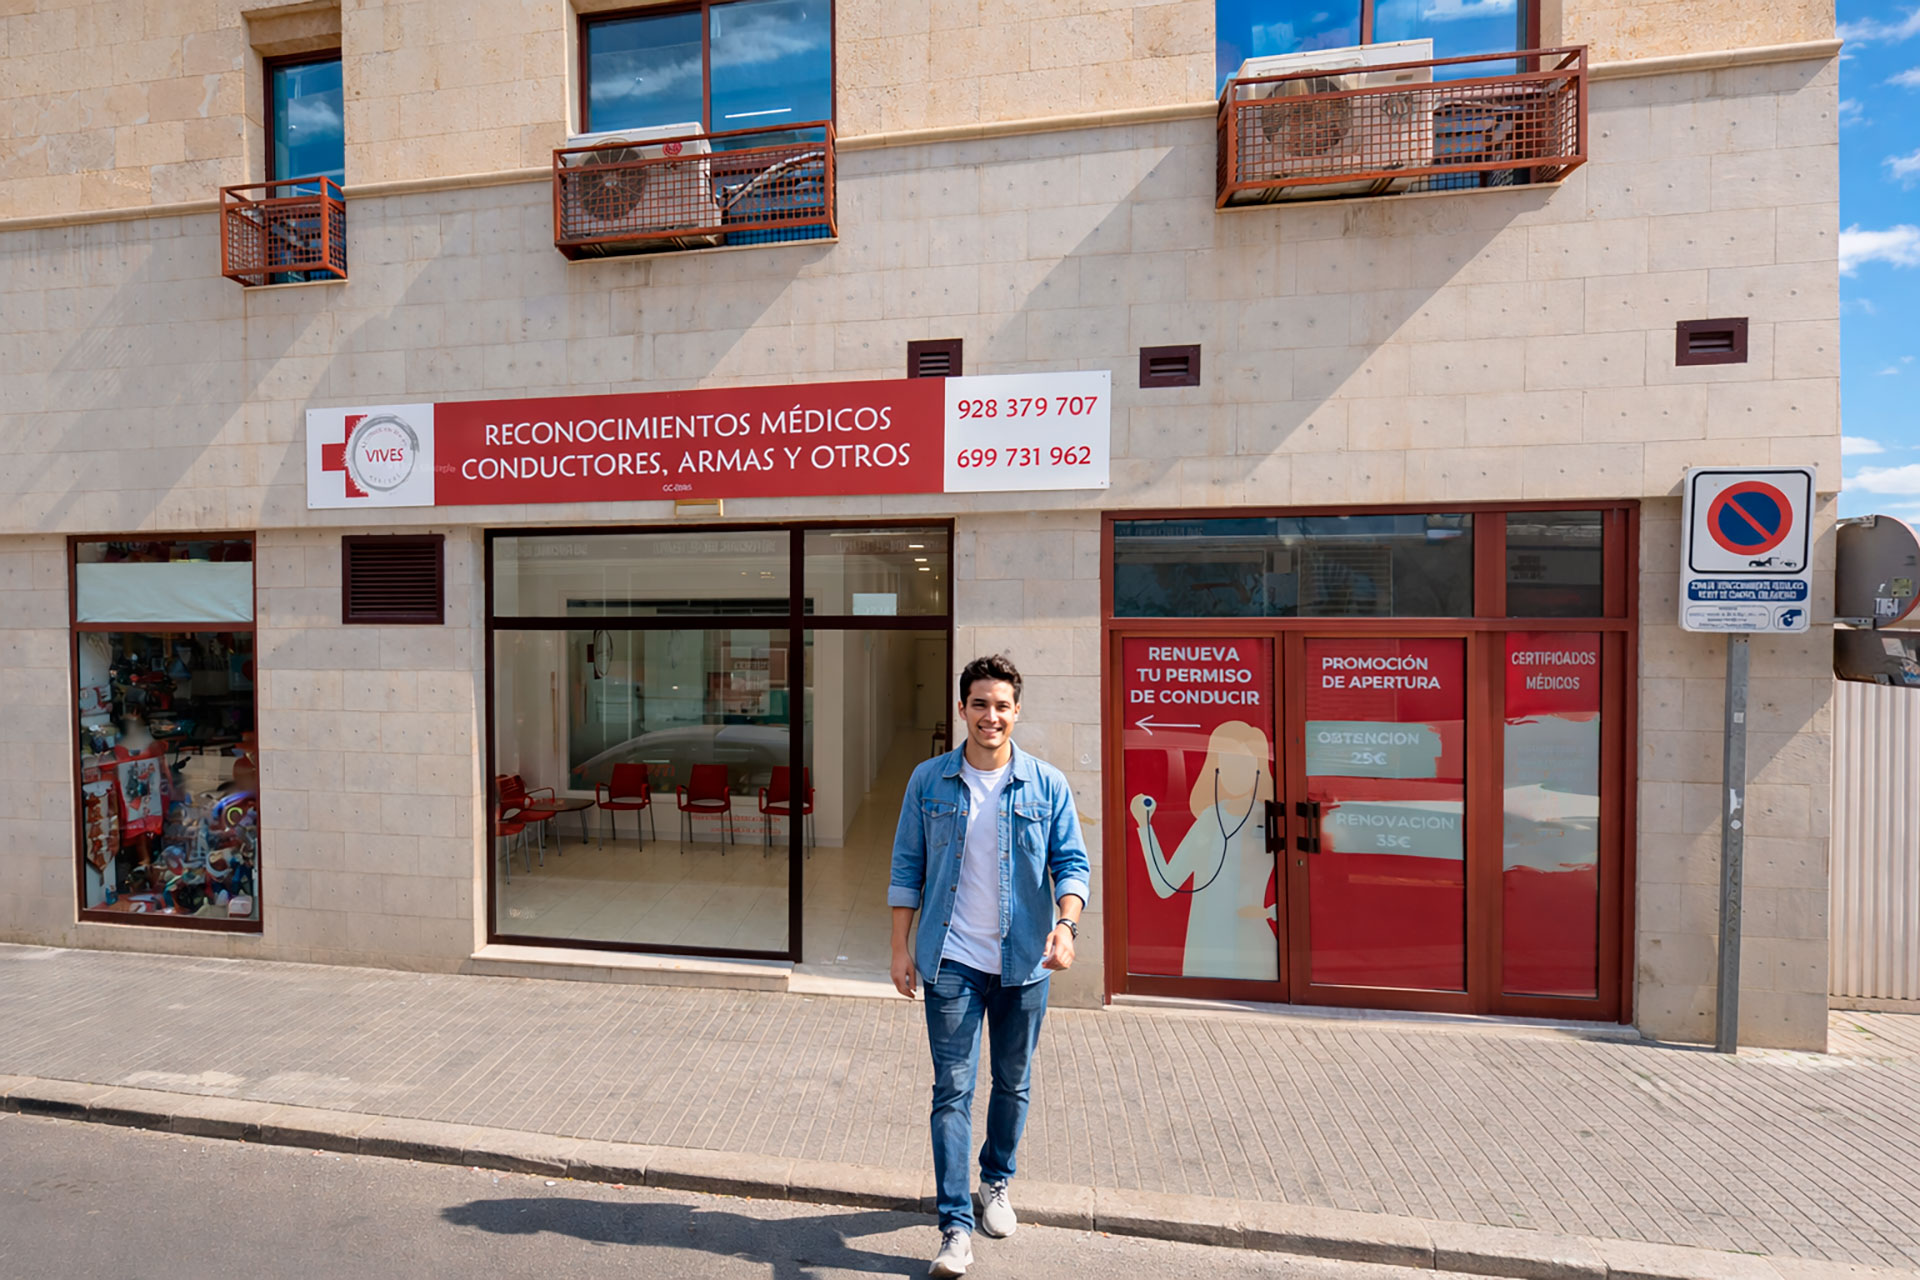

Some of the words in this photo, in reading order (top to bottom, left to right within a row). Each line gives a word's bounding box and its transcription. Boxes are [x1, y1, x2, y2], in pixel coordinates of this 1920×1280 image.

[957, 398, 998, 421] 928
[1006, 396, 1048, 418] 379
[1055, 395, 1099, 416] 707
[484, 412, 751, 446] RECONOCIMIENTOS
[760, 404, 892, 435] MÉDICOS
[365, 448, 404, 463] VIVES
[461, 451, 669, 480] CONDUCTORES,
[677, 447, 775, 473] ARMAS
[783, 446, 802, 469] Y
[810, 442, 911, 469] OTROS
[956, 447, 998, 469] 699
[1005, 447, 1041, 468] 731
[1049, 445, 1092, 466] 962
[1148, 646, 1240, 662] RENUEVA
[1322, 654, 1428, 671] PROMOCIÓN
[1136, 668, 1161, 682] TU
[1165, 668, 1252, 683] PERMISO
[1322, 675, 1346, 689] DE
[1348, 675, 1441, 690] APERTURA
[1526, 672, 1580, 690] MÉDICOS
[1130, 689, 1155, 704] DE
[1159, 689, 1260, 705] CONDUCIR
[1375, 833, 1411, 848] 35€
